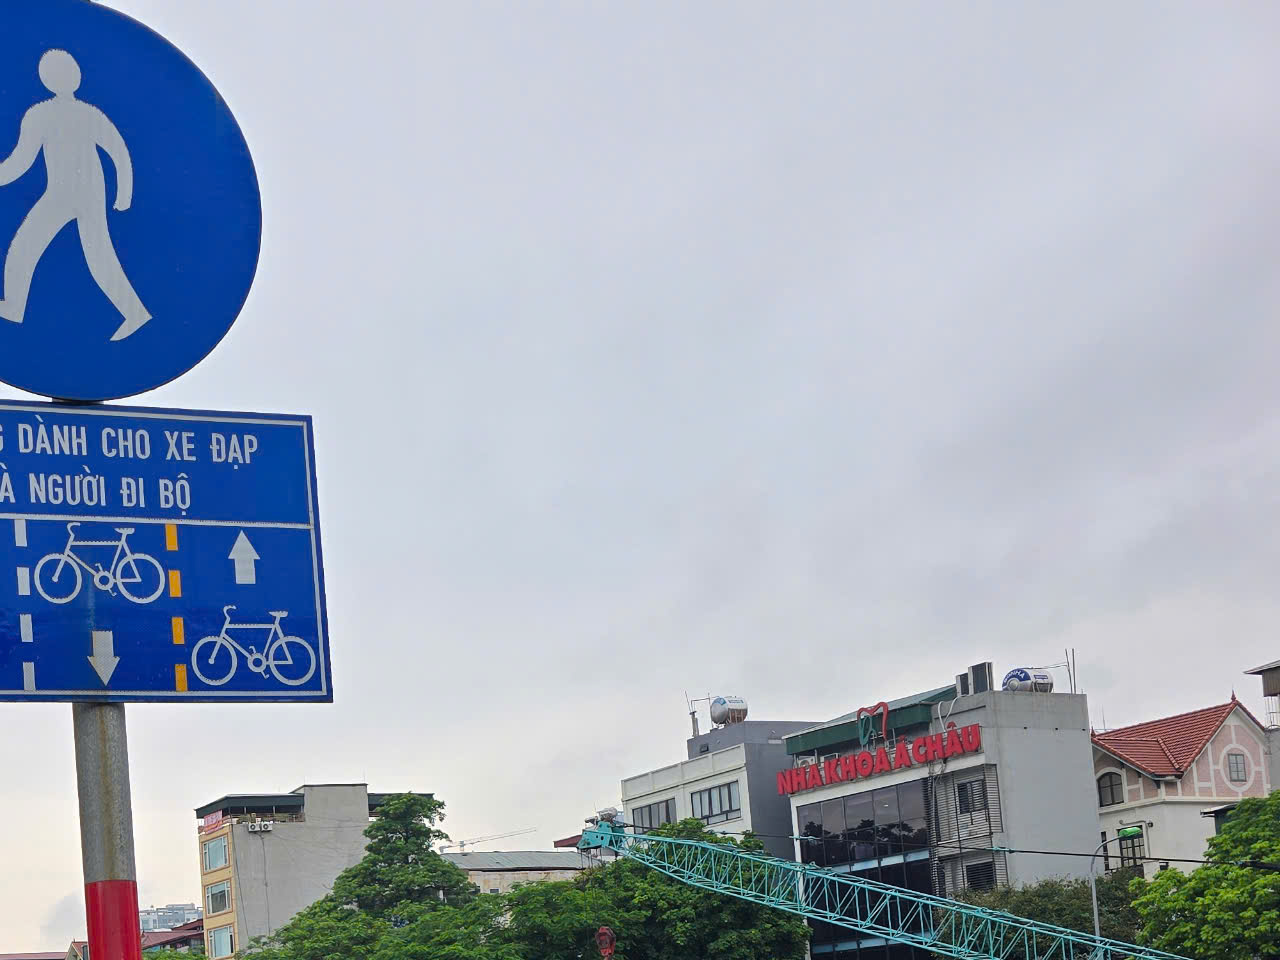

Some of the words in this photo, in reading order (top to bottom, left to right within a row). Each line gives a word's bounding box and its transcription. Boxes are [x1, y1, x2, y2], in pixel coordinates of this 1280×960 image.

[18, 414, 87, 456] DÀNH
[101, 427, 151, 459] CHO
[164, 430, 196, 461] XE
[210, 432, 258, 470] ĐẠP
[28, 465, 106, 507] NGƯỜI
[120, 476, 145, 508] ĐI
[159, 472, 191, 516] BỘ
[776, 763, 824, 796] NHA
[824, 747, 891, 786] KHOA
[894, 735, 912, 770] Á
[912, 721, 981, 764] CHÂU
